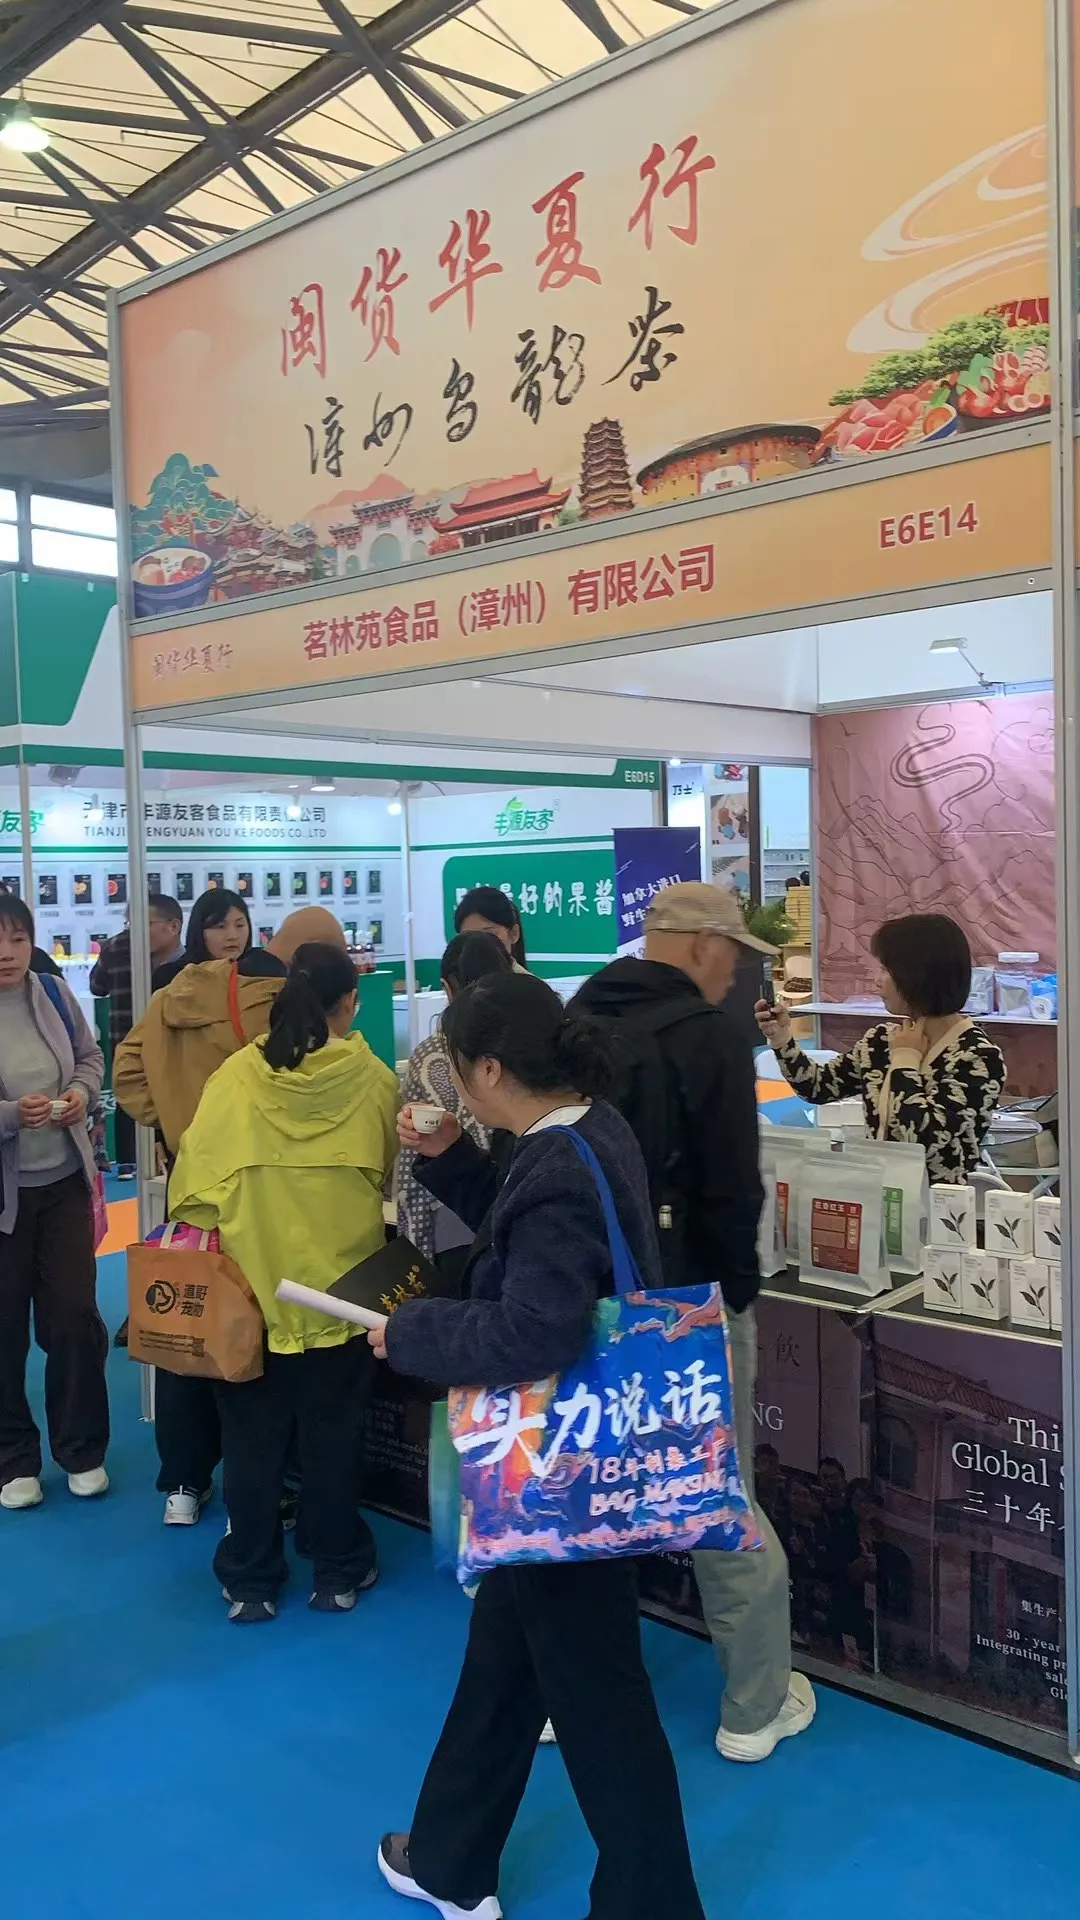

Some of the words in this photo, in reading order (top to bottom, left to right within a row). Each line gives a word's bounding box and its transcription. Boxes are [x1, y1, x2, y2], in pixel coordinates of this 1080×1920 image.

[280, 134, 716, 378] 闽货华夏行
[879, 502, 979, 550] E6E14
[303, 544, 716, 662] 茗林苑食品（漳州）有限公司
[625, 770, 655, 783] E6D15
[84, 826, 126, 837] TIANJI
[146, 826, 205, 838] ENGYUAN
[208, 827, 231, 838] YOU
[250, 828, 285, 838] FOODS
[453, 878, 616, 917] 好的果酱
[620, 905, 651, 927] 野生
[951, 1441, 1051, 1488] Global
[963, 1489, 1065, 1532] 三十年
[976, 1634, 1050, 1667] Integrating
[1006, 1628, 1020, 1640] 30
